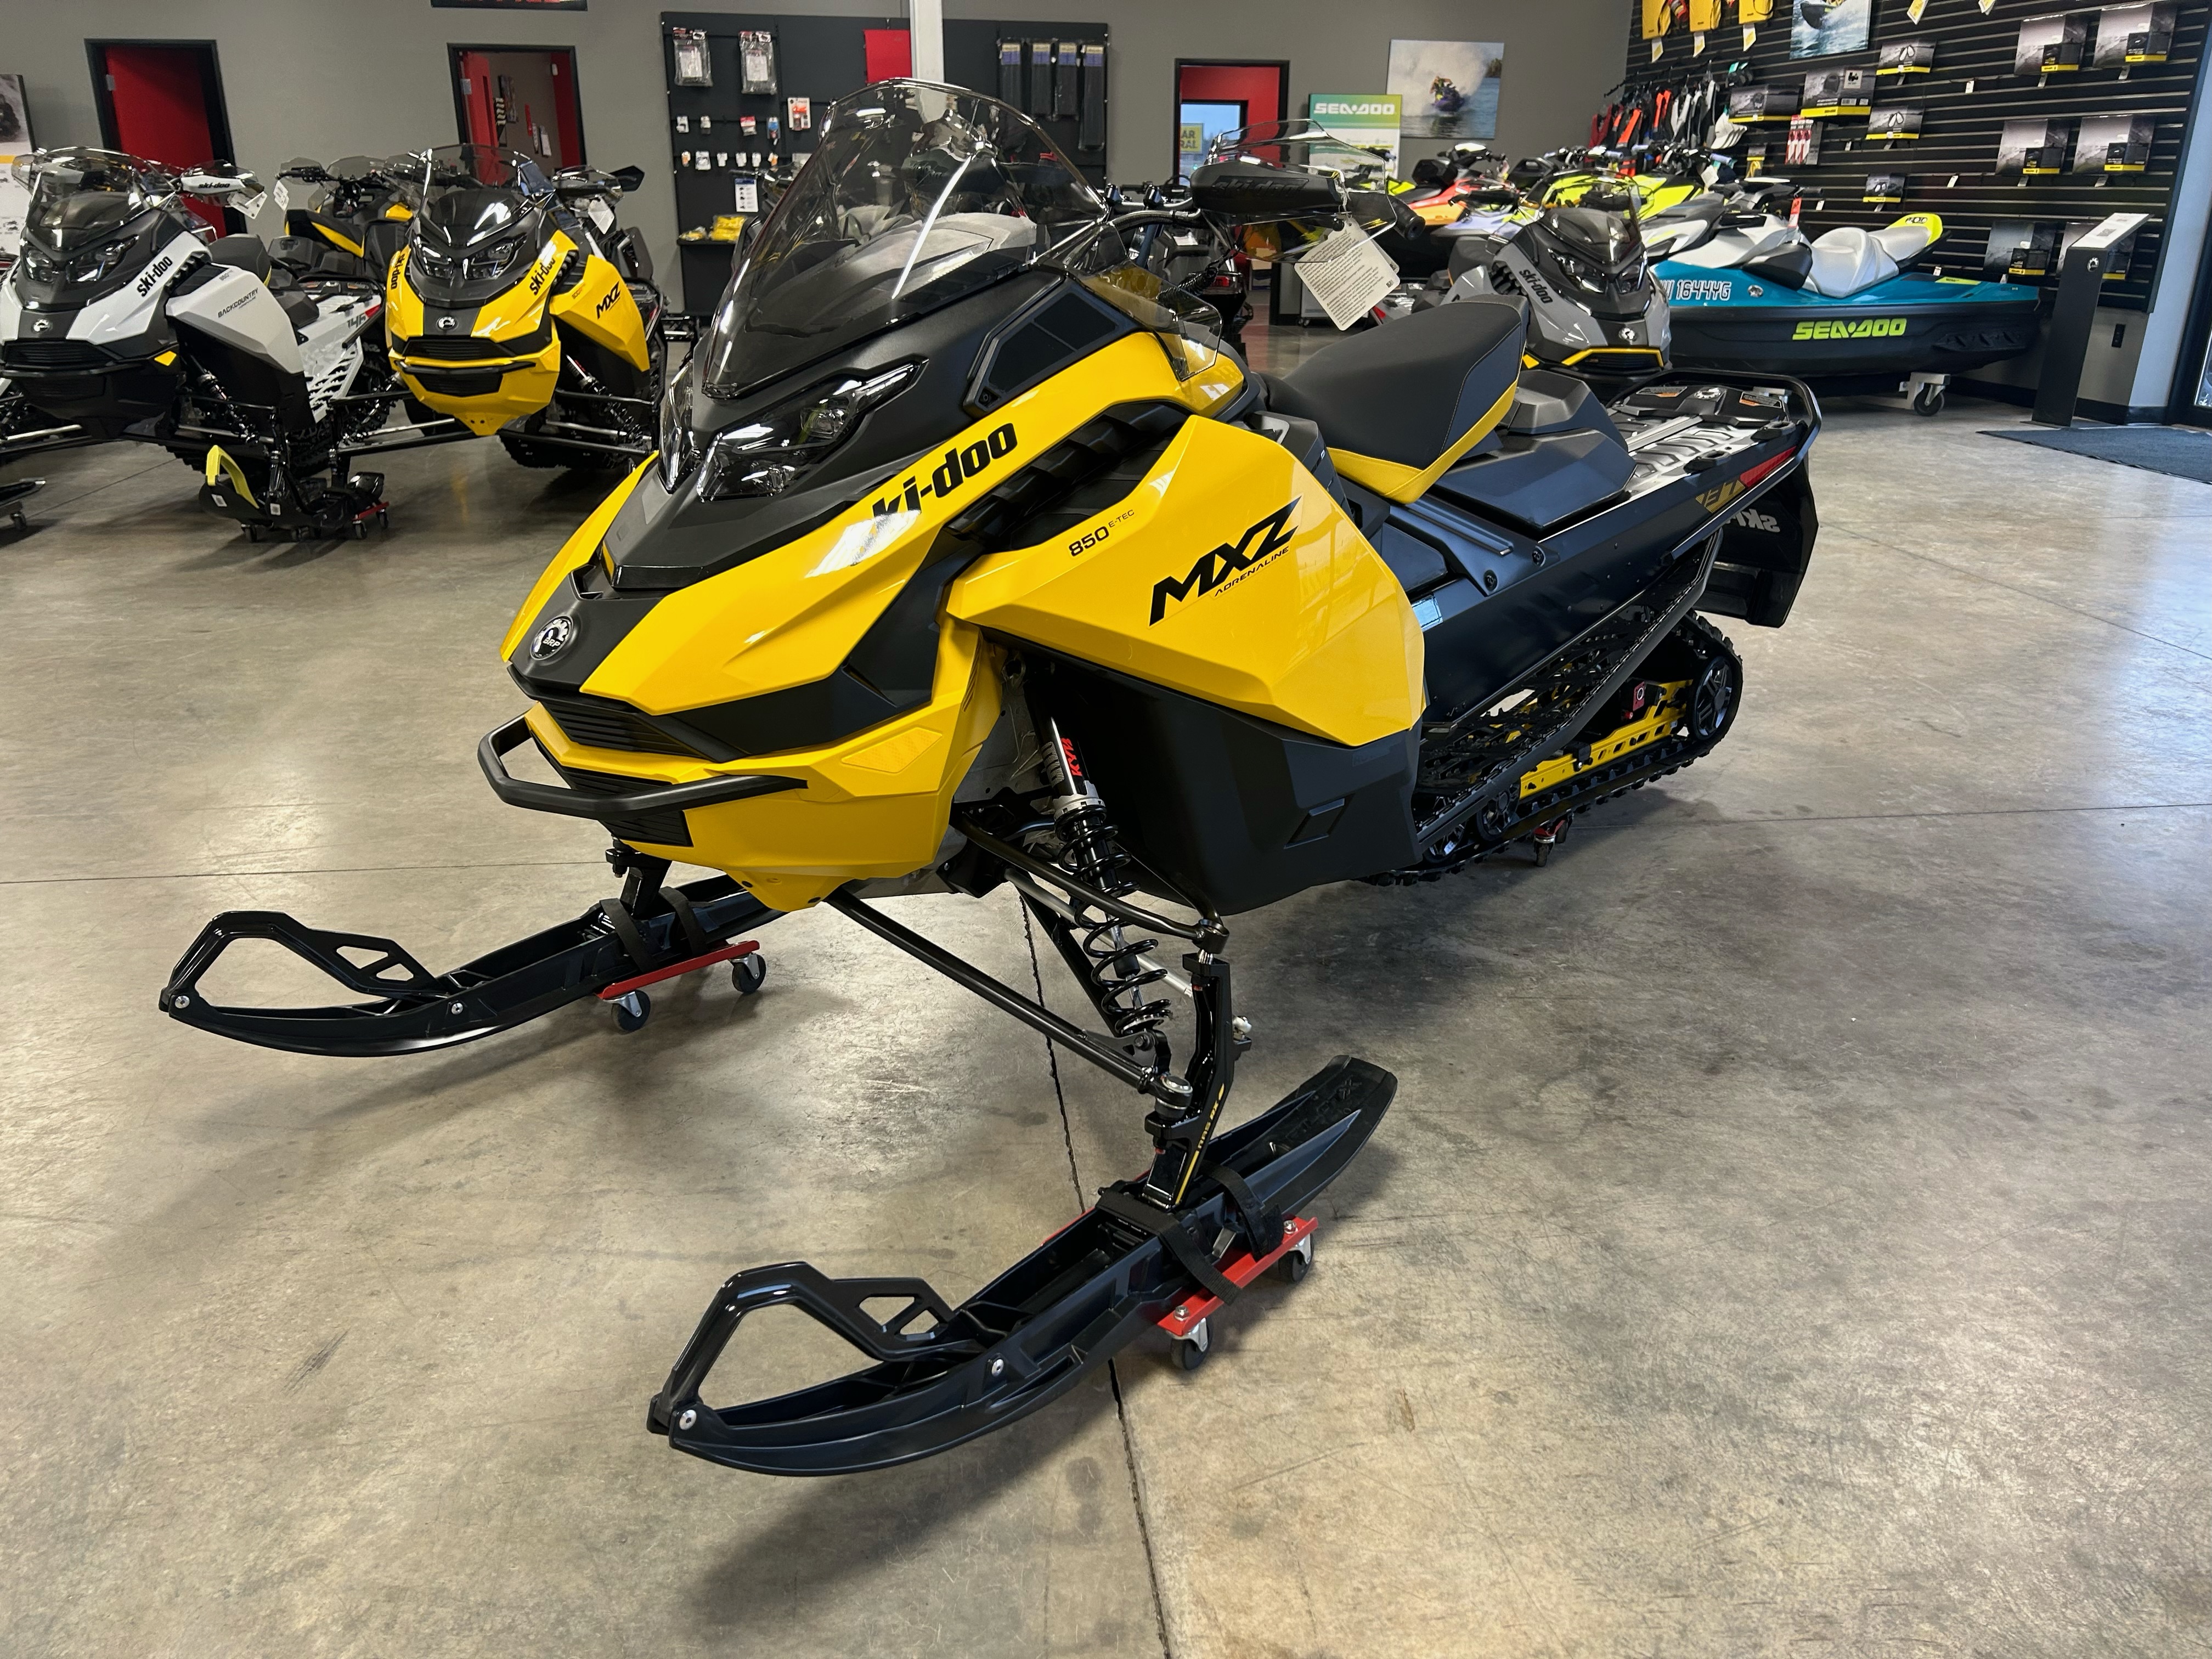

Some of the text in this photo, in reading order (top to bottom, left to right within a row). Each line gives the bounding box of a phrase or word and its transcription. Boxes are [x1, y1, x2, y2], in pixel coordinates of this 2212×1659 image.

[137, 256, 173, 297] ski-doo
[1519, 269, 1553, 303] ski-doo
[218, 287, 258, 318] BACKCOUNTRY
[596, 281, 622, 319] MXZ
[1068, 509, 1135, 557] 850 E-TEC
[1149, 495, 1302, 627] MXZ
[1214, 546, 1289, 597] ADRENALINE
[542, 637, 561, 647] BRP
[1060, 737, 1083, 776] KYB
